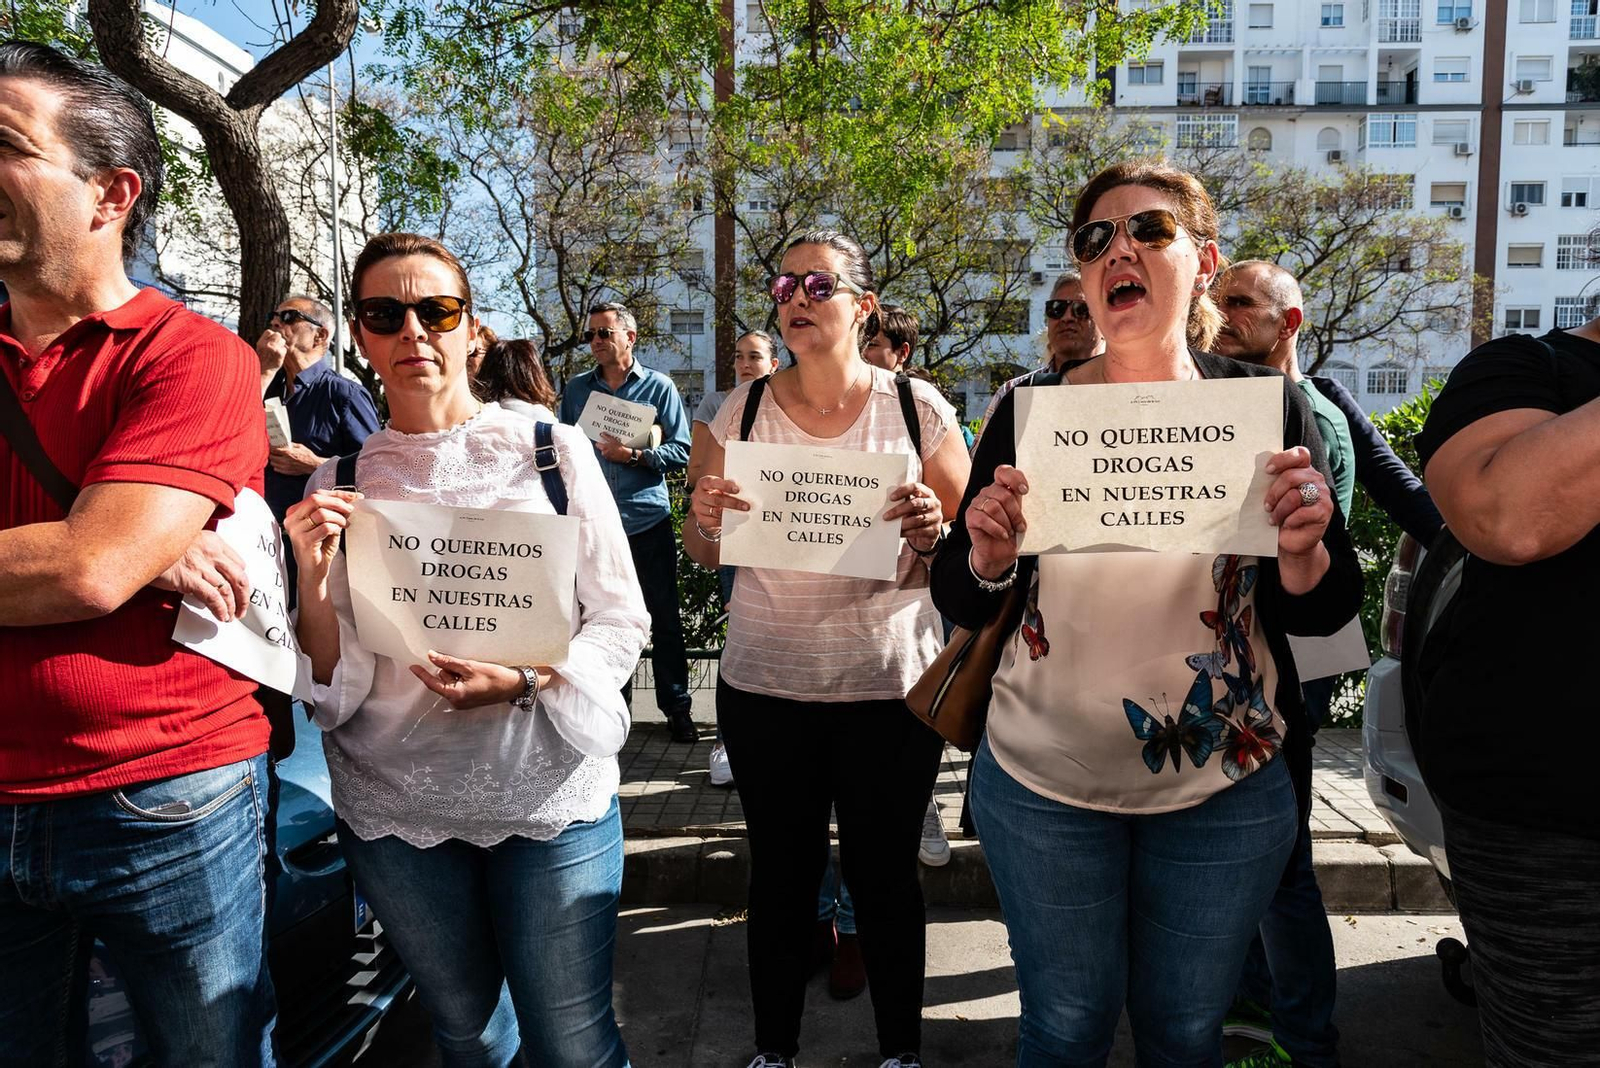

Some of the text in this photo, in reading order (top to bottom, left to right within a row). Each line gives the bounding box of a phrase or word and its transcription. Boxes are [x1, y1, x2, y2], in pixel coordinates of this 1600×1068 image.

[596, 404, 642, 423] NO QUEREMOS
[603, 415, 630, 428] DROGAS
[592, 420, 602, 429] EN
[602, 424, 635, 438] NUESTRAS
[1053, 424, 1236, 449] NO QUEREMOS
[1092, 455, 1194, 474] DROGAS
[759, 469, 880, 490] NO QUEREMOS
[784, 490, 852, 506] DROGAS
[1061, 484, 1227, 503] EN NUESTRAS
[761, 510, 872, 529] EN NUESTRAS
[1100, 510, 1185, 527] CALLES
[257, 534, 277, 558] NO
[388, 534, 543, 560] NO QUEREMOS
[786, 530, 844, 545] CALLES
[420, 561, 508, 582] DROGAS
[249, 588, 272, 610] EN
[391, 586, 533, 610] EN NUESTRAS
[422, 613, 498, 632] CALLES
[265, 626, 296, 652] CAL
